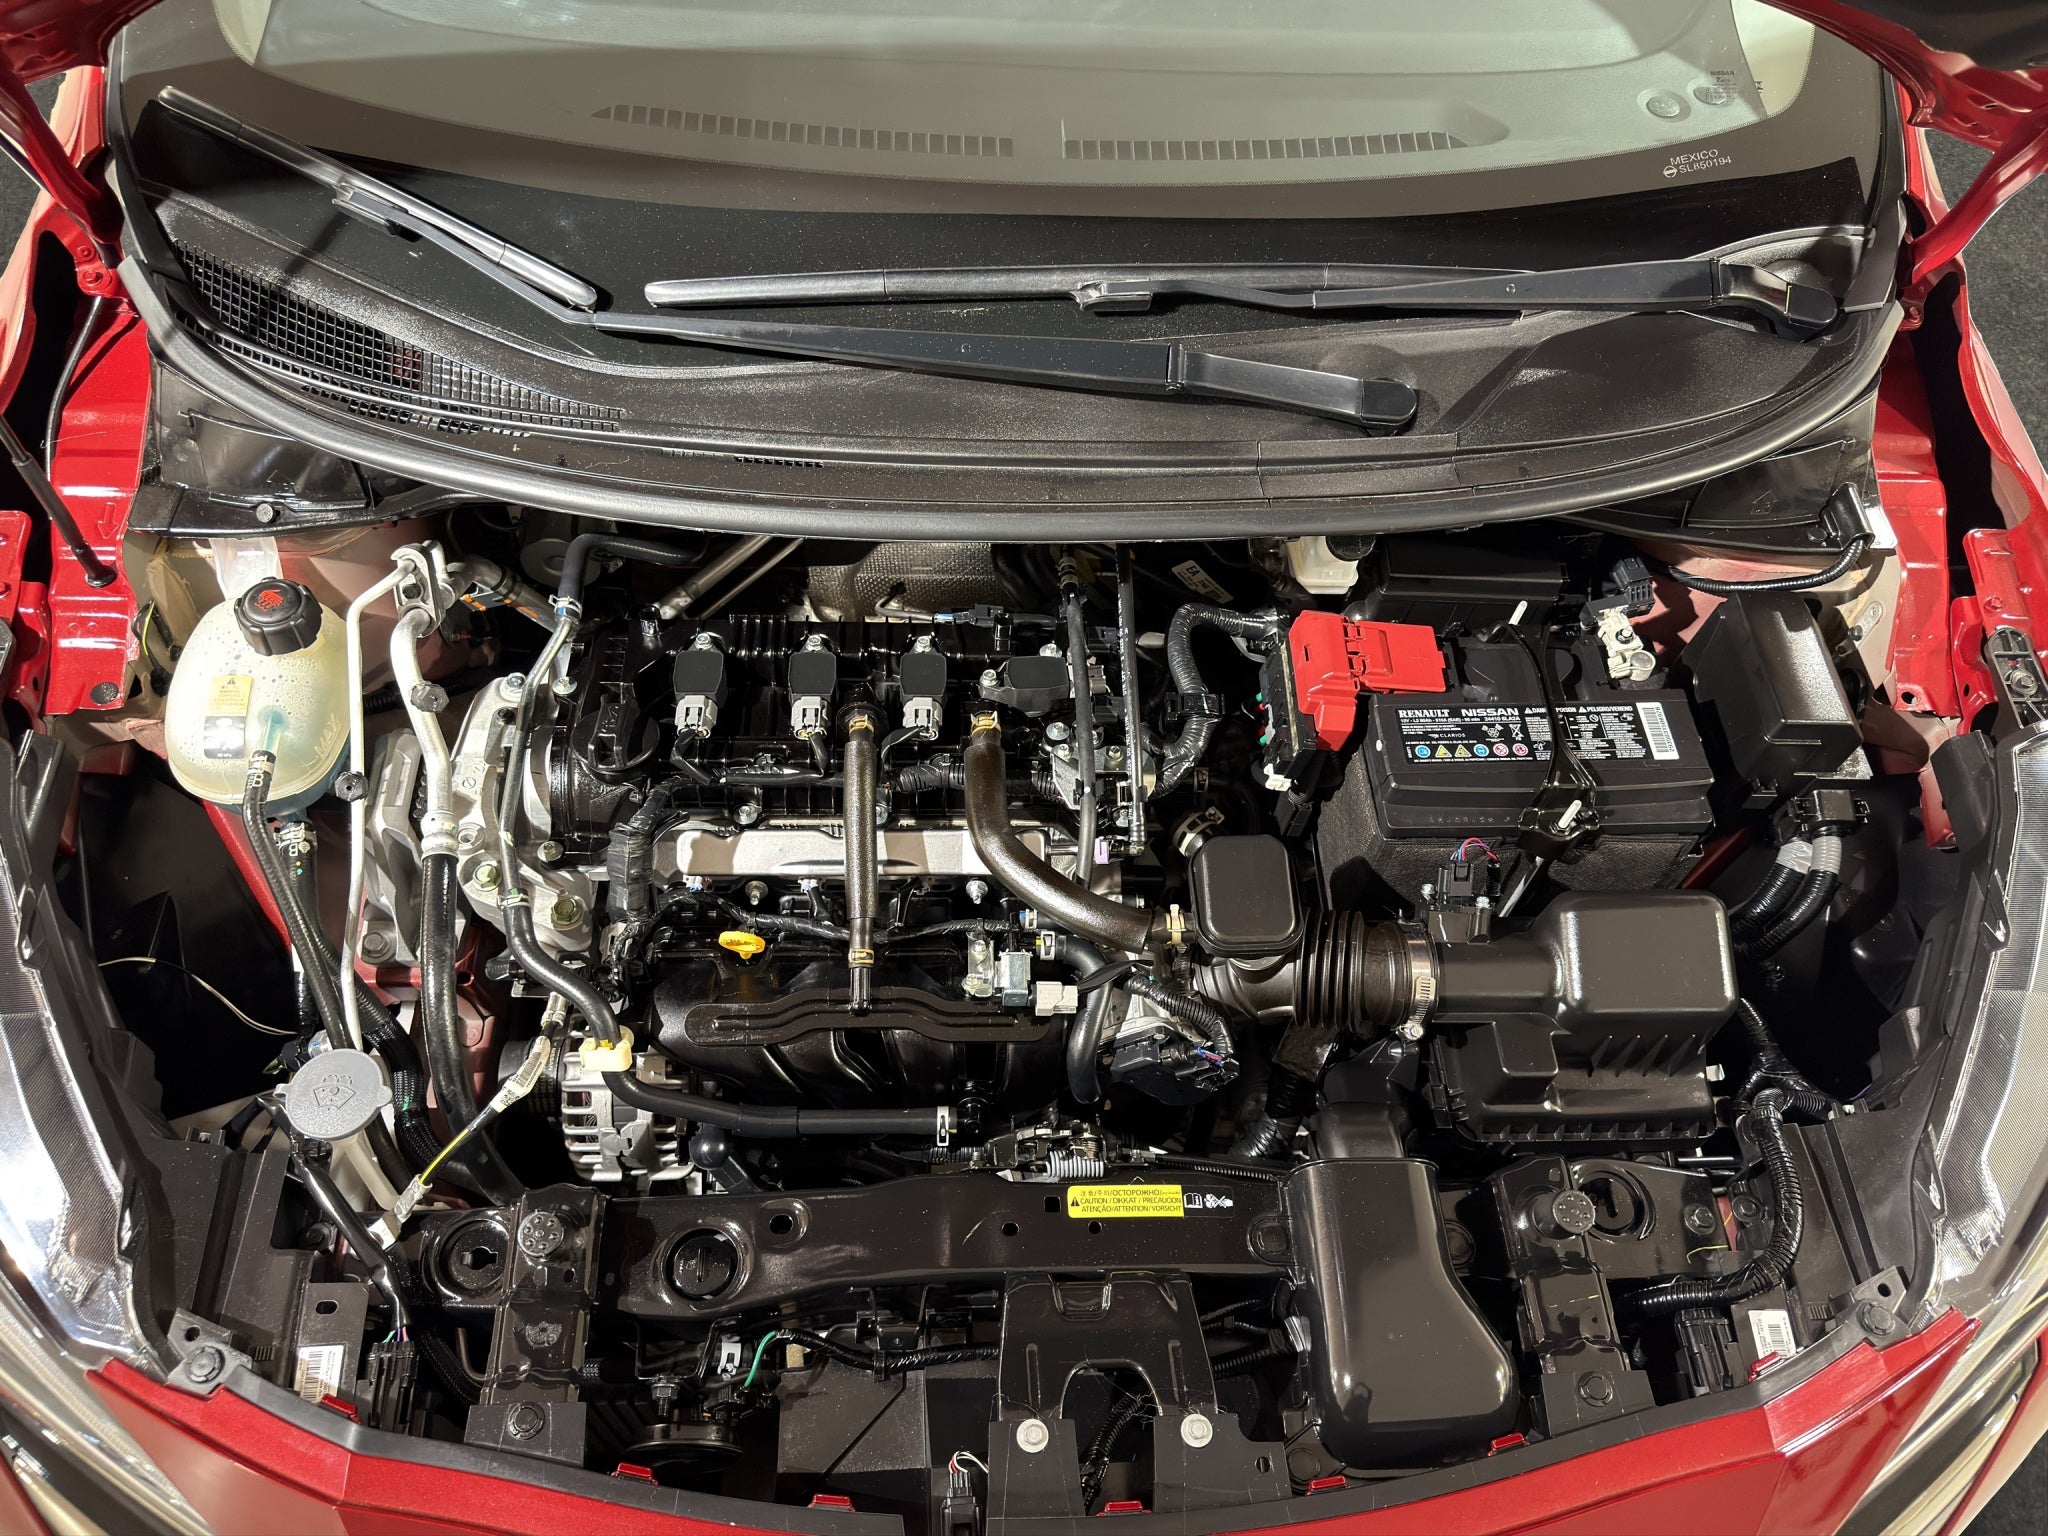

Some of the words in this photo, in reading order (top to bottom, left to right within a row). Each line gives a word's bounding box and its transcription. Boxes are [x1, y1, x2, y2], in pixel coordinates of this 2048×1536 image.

[1670, 149, 1718, 165] MEXICO
[1679, 156, 1732, 173] SL850194
[1186, 565, 1201, 577] EA
[1398, 709, 1450, 718] RENAULT
[1461, 707, 1519, 717] NISSAN
[1080, 1197, 1107, 1205] CAUTION
